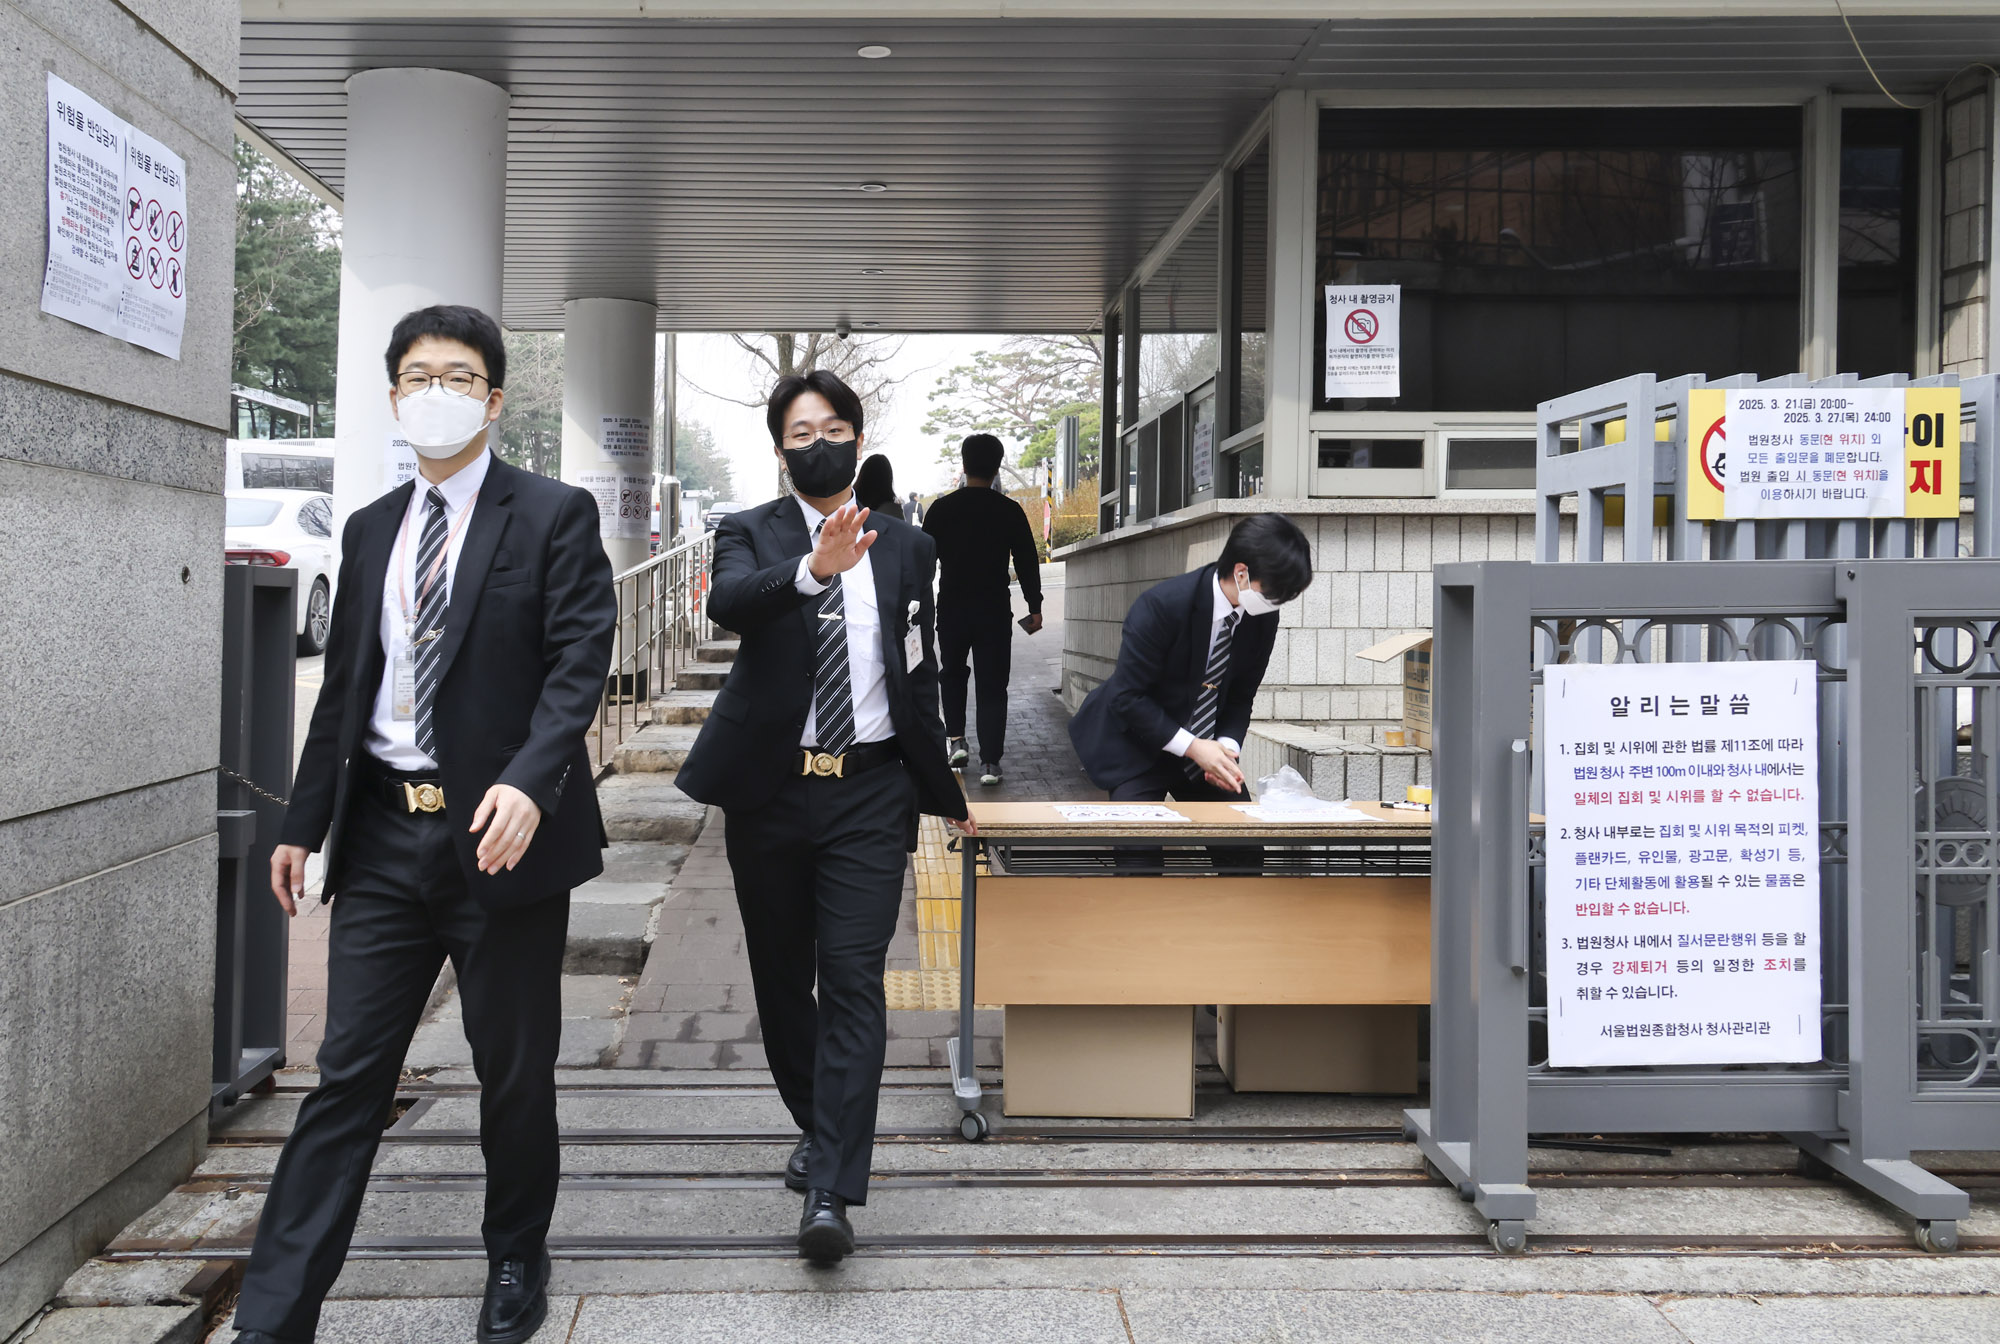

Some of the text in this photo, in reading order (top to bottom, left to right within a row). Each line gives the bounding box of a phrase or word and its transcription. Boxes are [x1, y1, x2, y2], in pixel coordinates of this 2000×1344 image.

[57, 101, 117, 152] 위험물 반입금지
[130, 146, 182, 192] 위험물 반입금지
[1330, 294, 1394, 304] 청사 내 촬영금지
[1739, 399, 1765, 409] 2025.
[1771, 399, 1779, 409] 3.
[1821, 399, 1853, 409] 20:00~
[1784, 413, 1810, 423] 2025.
[1815, 413, 1822, 423] 3.
[1865, 412, 1891, 422] 24:00
[1749, 435, 1793, 446] 법원청사
[1872, 434, 1880, 444] 외
[1748, 452, 1882, 464] 모든 출입문을 폐문합니다.
[1740, 470, 1761, 482] 법원
[1767, 470, 1789, 482] 출입
[1796, 470, 1806, 482] 시
[1761, 488, 1868, 500] 이용하시기 바랍니다.
[1560, 738, 1804, 755] 1. 집회 및 시위에 관한 법률 제11조에 따라
[1629, 765, 1653, 778] 주변
[1656, 766, 1686, 777] 100m
[1688, 764, 1725, 777] 이내와
[1727, 763, 1752, 777] 청사
[1755, 763, 1804, 776] 내에서는
[1574, 788, 1804, 805] 일체의 집회 및 시위를 할 수 없습니다.
[1561, 823, 1808, 840] 2. 청사 내부로는 집회 및 시위 목적의 피켓,
[1575, 848, 1804, 865] 플랜카드, 유인물, 광고문, 확성기 등,
[1576, 874, 1805, 891] 기타 단체활동에 활용될 수 있는 물품은
[1576, 901, 1689, 916] 반입할 수 없습니다.
[1562, 932, 1806, 950] 3. 법원청사 내에서 질서문란행위 등을 할
[1577, 958, 1806, 976] 경우 강제퇴거 등의 일정한 조치를
[1577, 985, 1677, 1000] 취할 수 있습니다.
[1601, 1022, 1771, 1038] 서울법원종합청사 청사관리관
